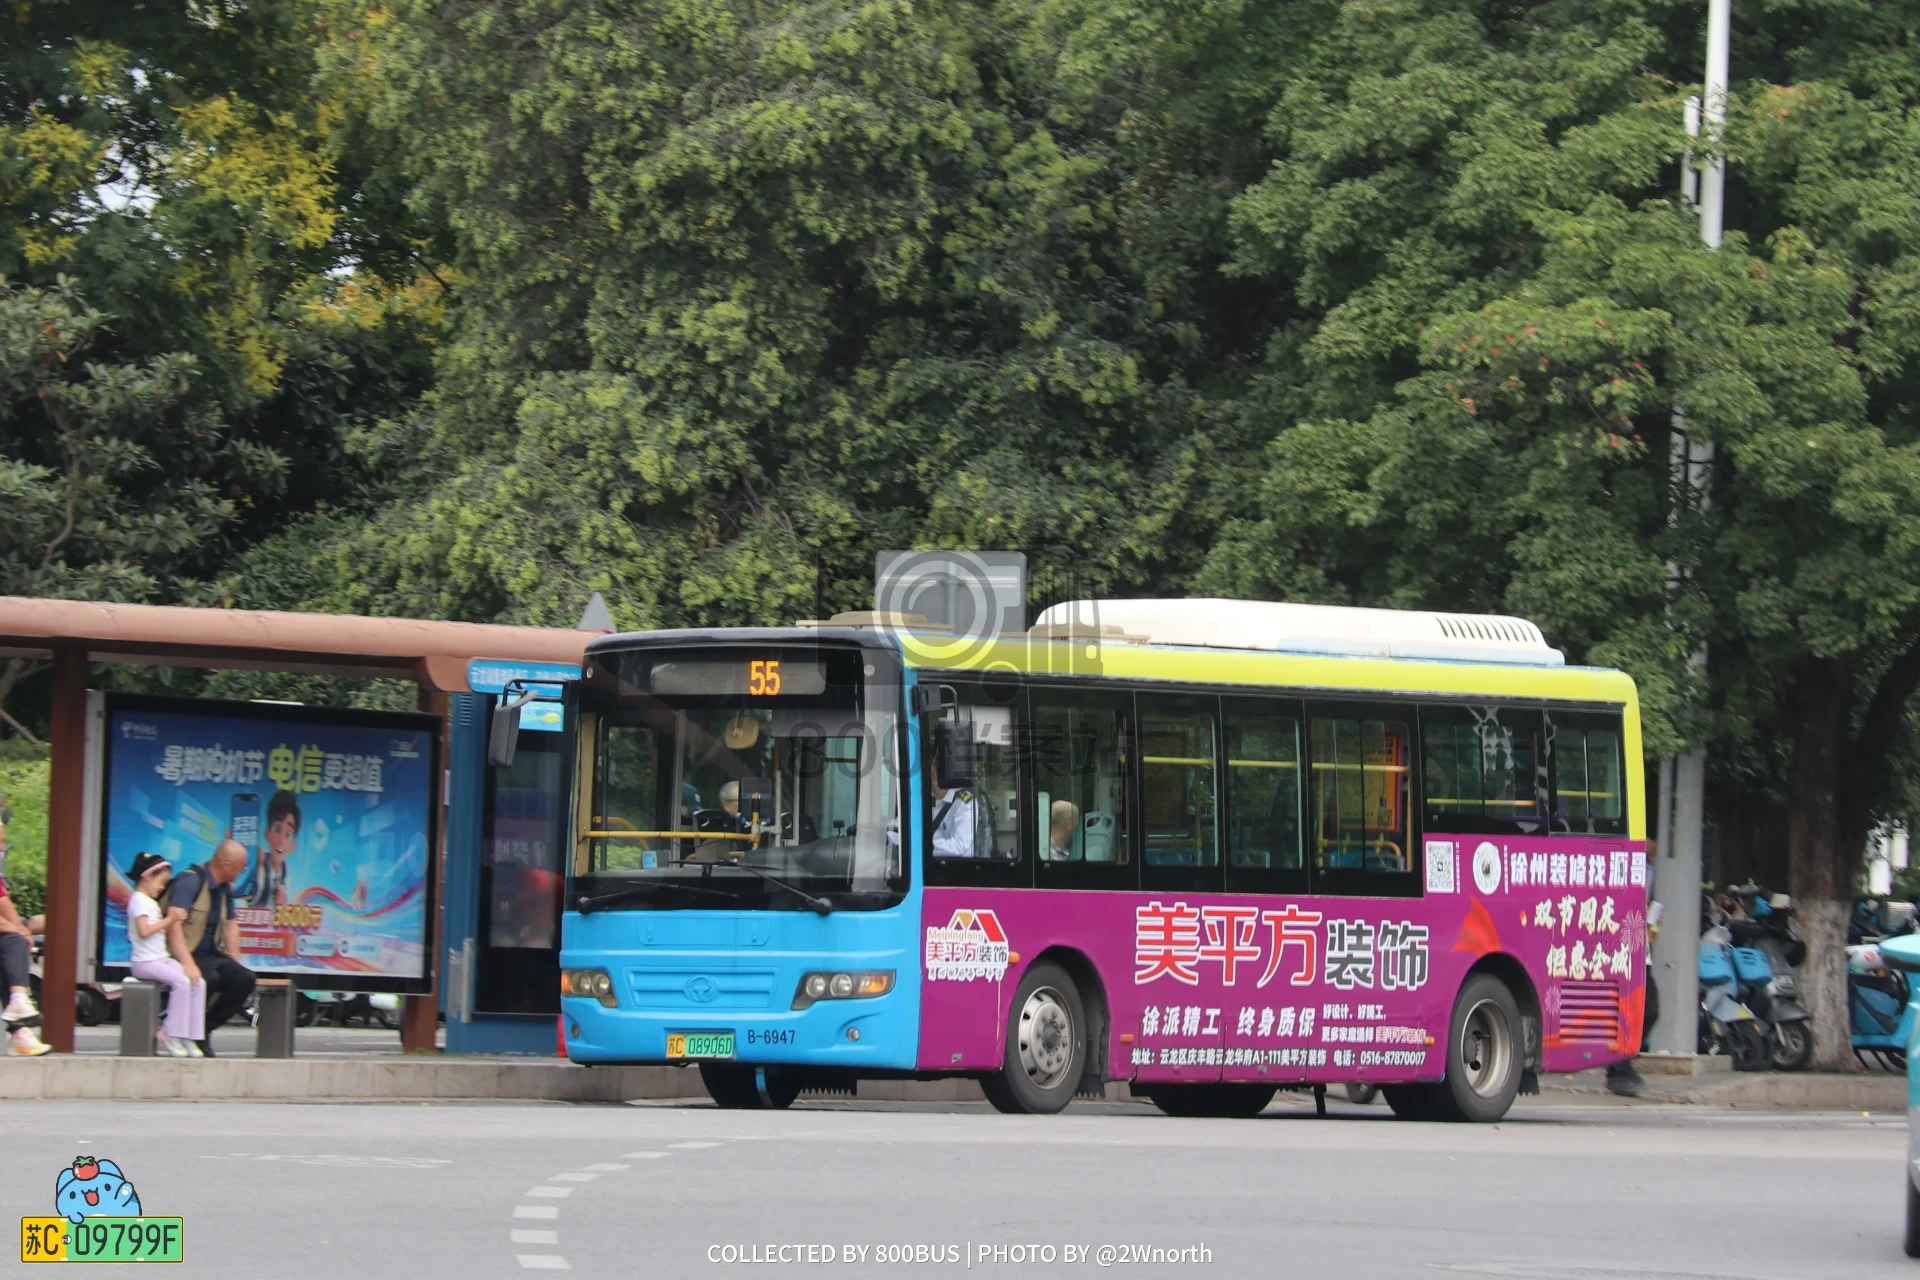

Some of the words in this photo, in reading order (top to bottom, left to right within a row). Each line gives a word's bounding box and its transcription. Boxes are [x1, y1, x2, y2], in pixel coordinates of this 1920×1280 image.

[750, 660, 781, 696] 55
[927, 941, 1007, 963] 美平方装饰
[1134, 901, 1429, 991] 美平方装饰
[747, 1029, 796, 1044] B-6947
[1142, 1005, 1221, 1036] 徐派精工
[1236, 1006, 1316, 1037] 终身质保
